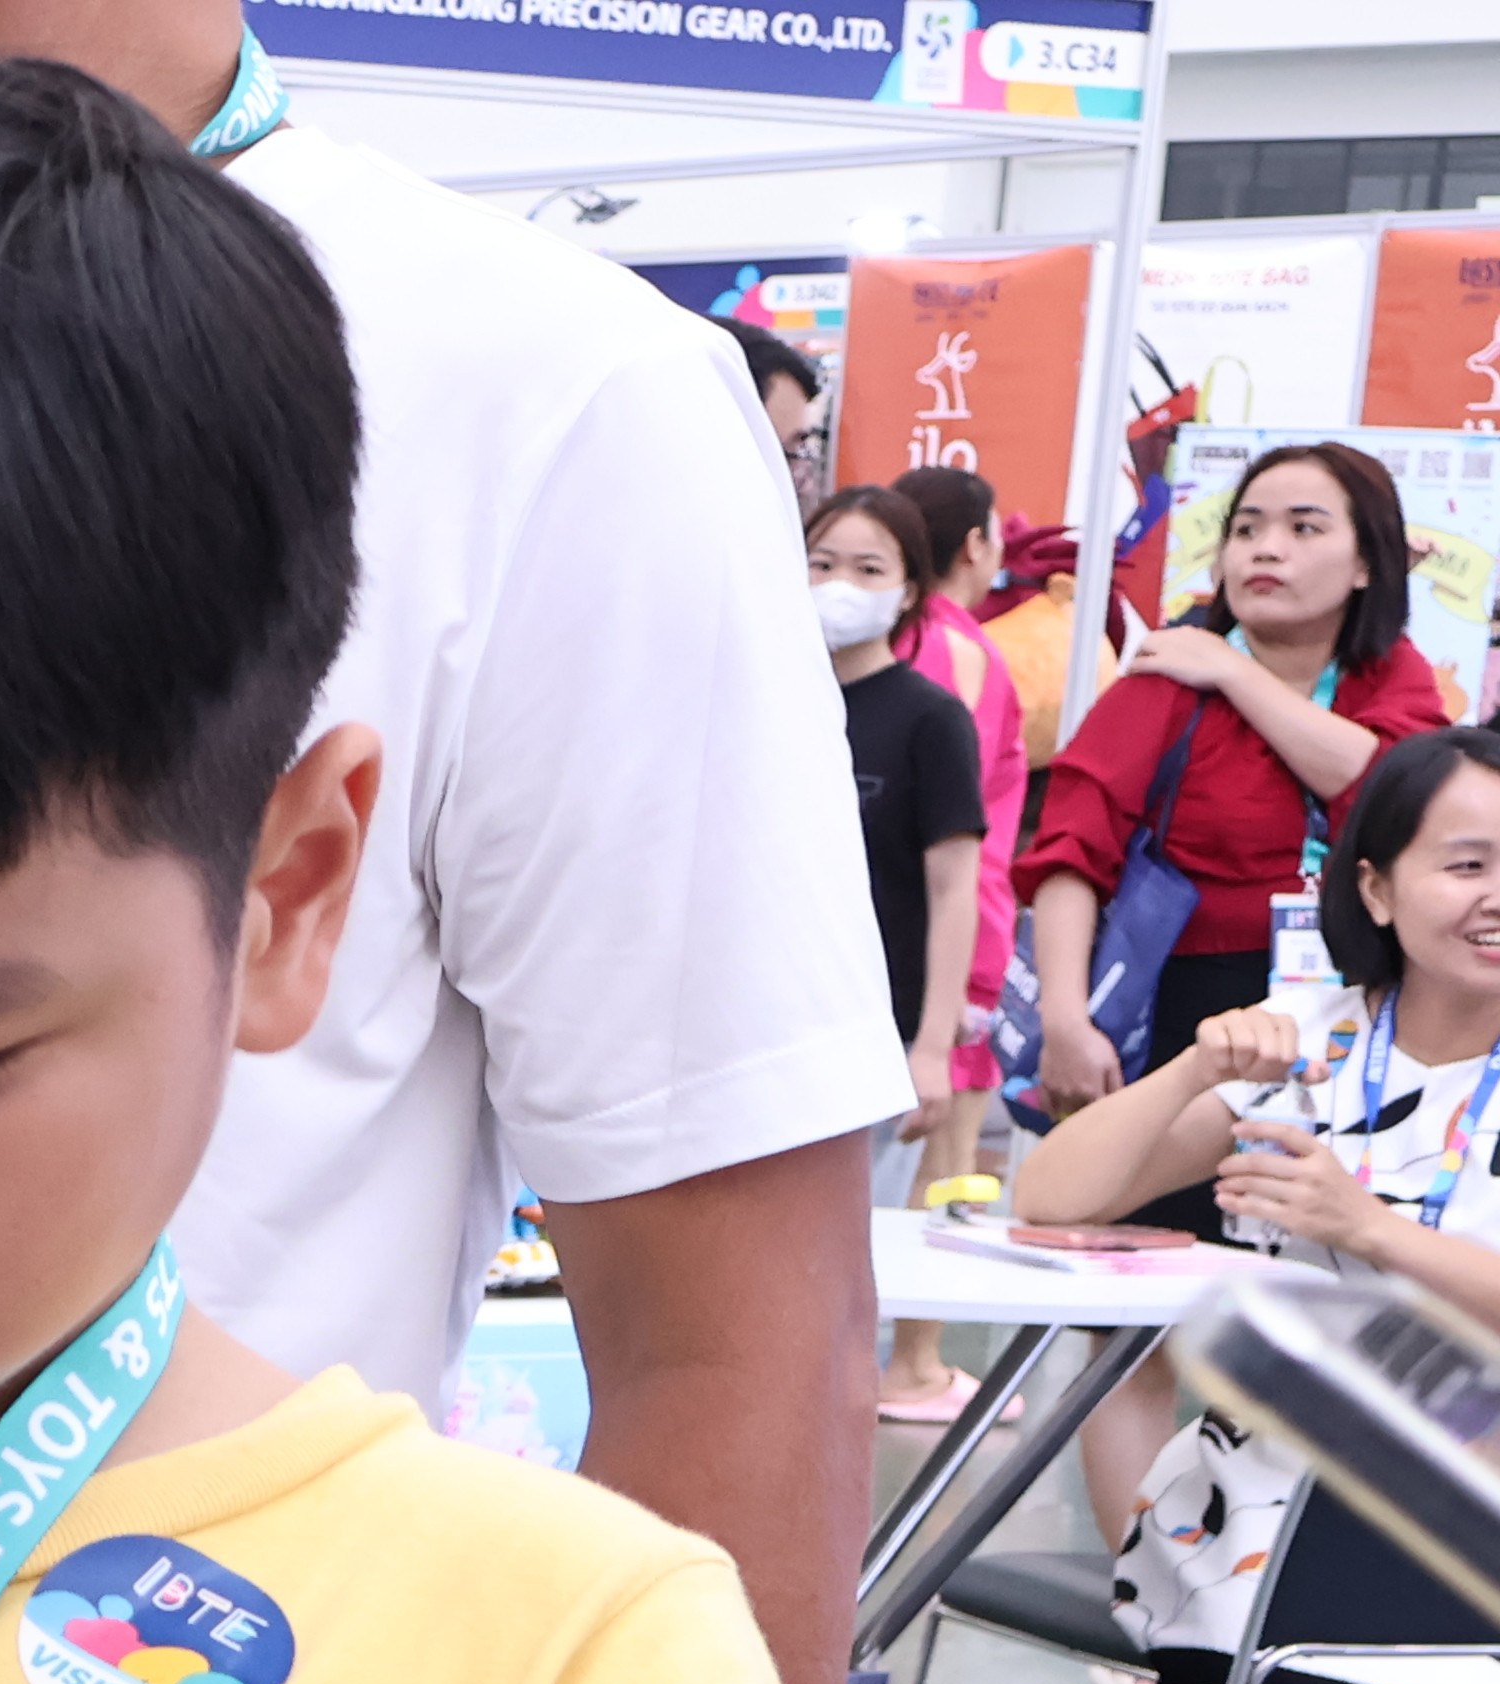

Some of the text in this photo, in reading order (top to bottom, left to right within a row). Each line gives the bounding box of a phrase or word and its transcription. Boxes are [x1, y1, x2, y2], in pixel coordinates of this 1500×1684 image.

[521, 0, 682, 37] PRECISION
[686, 4, 767, 43] GEAR
[771, 11, 894, 53] CO.,LTD.
[1038, 40, 1118, 73] 3.C34
[100, 1318, 150, 1380] &
[132, 1555, 270, 1652] IBTE
